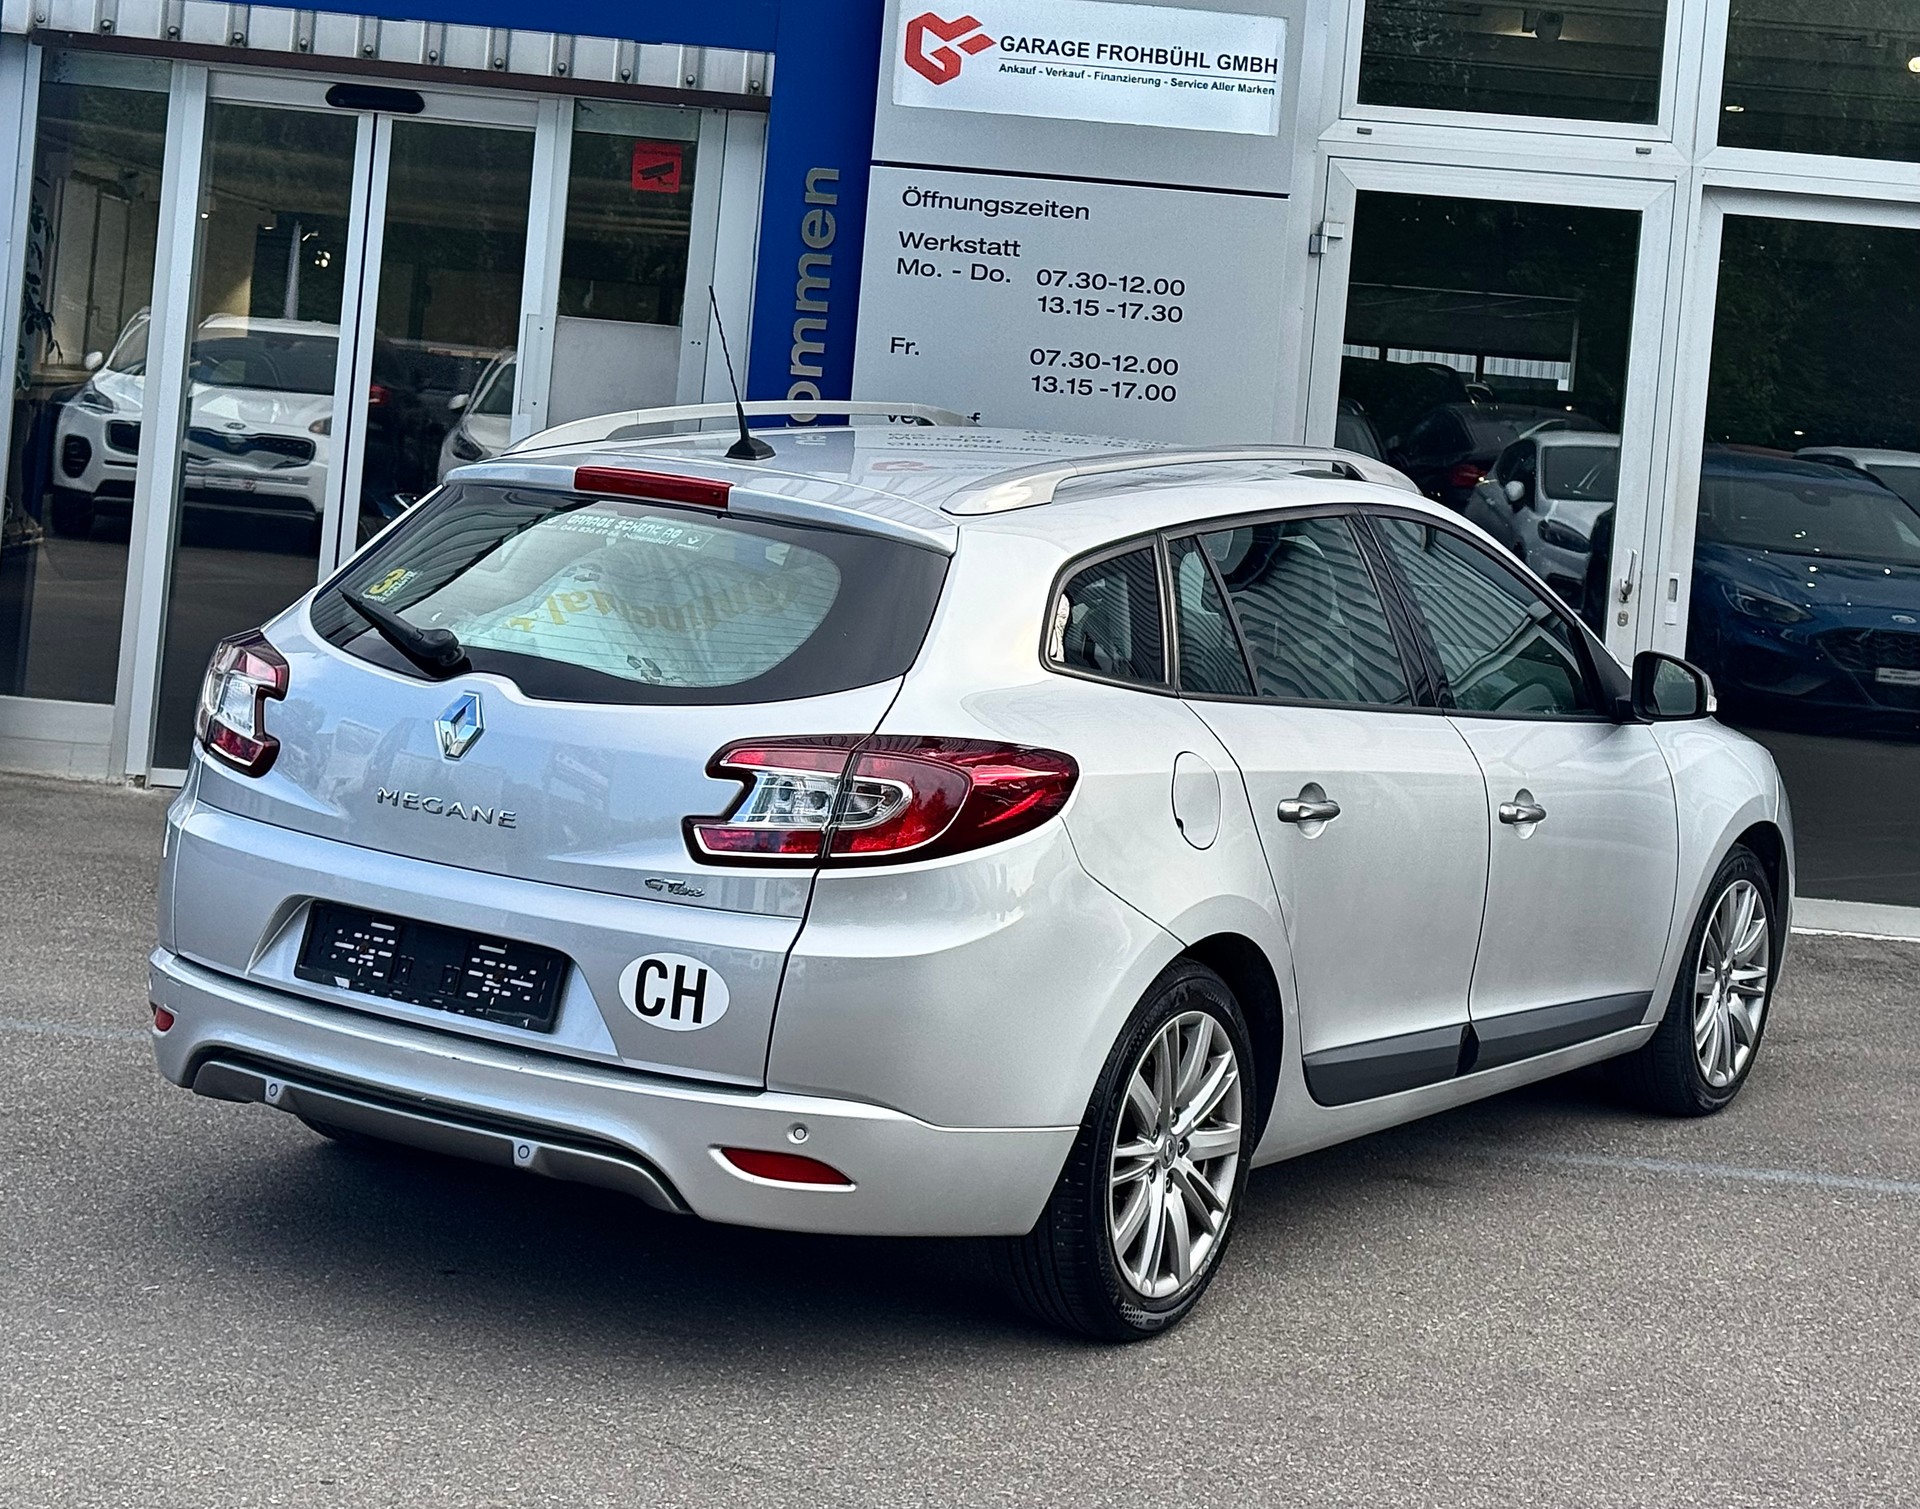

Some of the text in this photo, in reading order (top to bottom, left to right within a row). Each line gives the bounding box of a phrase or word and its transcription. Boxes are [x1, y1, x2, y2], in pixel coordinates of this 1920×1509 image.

[1000, 36, 1278, 74] GARAGE FROHBÜHL GMBH
[999, 63, 1037, 75] Ankauf
[1046, 67, 1085, 79] Verkauf
[1094, 71, 1161, 87] Finanzierung
[1170, 77, 1208, 90] Service
[1211, 81, 1235, 92] Aller
[1237, 83, 1275, 95] Marken
[902, 186, 1089, 220] Öffnungszeiten
[899, 231, 1021, 257] Werkstatt
[896, 257, 942, 277] Mo.
[970, 263, 1011, 283] Do.
[1036, 269, 1185, 296] 07.30-12.00
[786, 167, 839, 427] ommen
[890, 337, 1178, 376] Fr. 07.30-12.00
[377, 786, 517, 829] MEGANE
[635, 958, 708, 1024] CH
